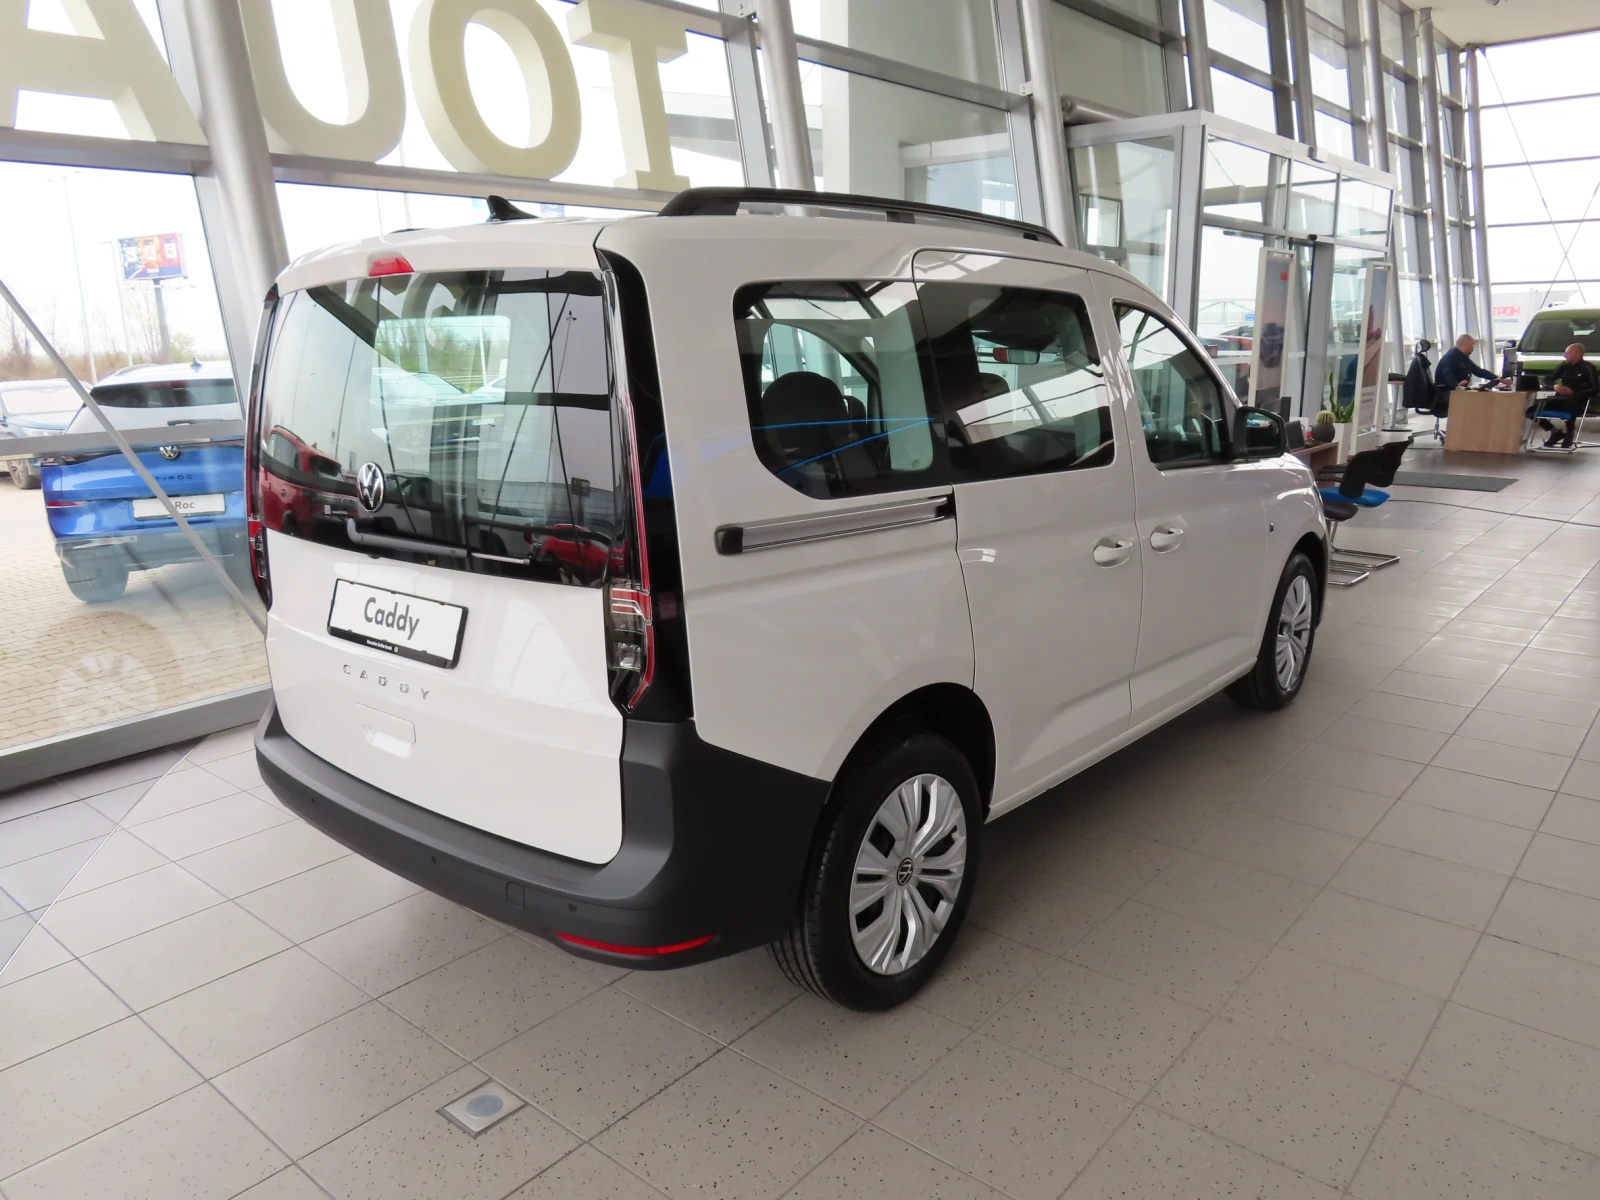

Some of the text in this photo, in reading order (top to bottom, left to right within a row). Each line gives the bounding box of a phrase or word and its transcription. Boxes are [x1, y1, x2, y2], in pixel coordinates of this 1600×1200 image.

[174, 501, 195, 509] Roc
[364, 597, 420, 640] Caddy
[343, 664, 430, 700] CADDY
